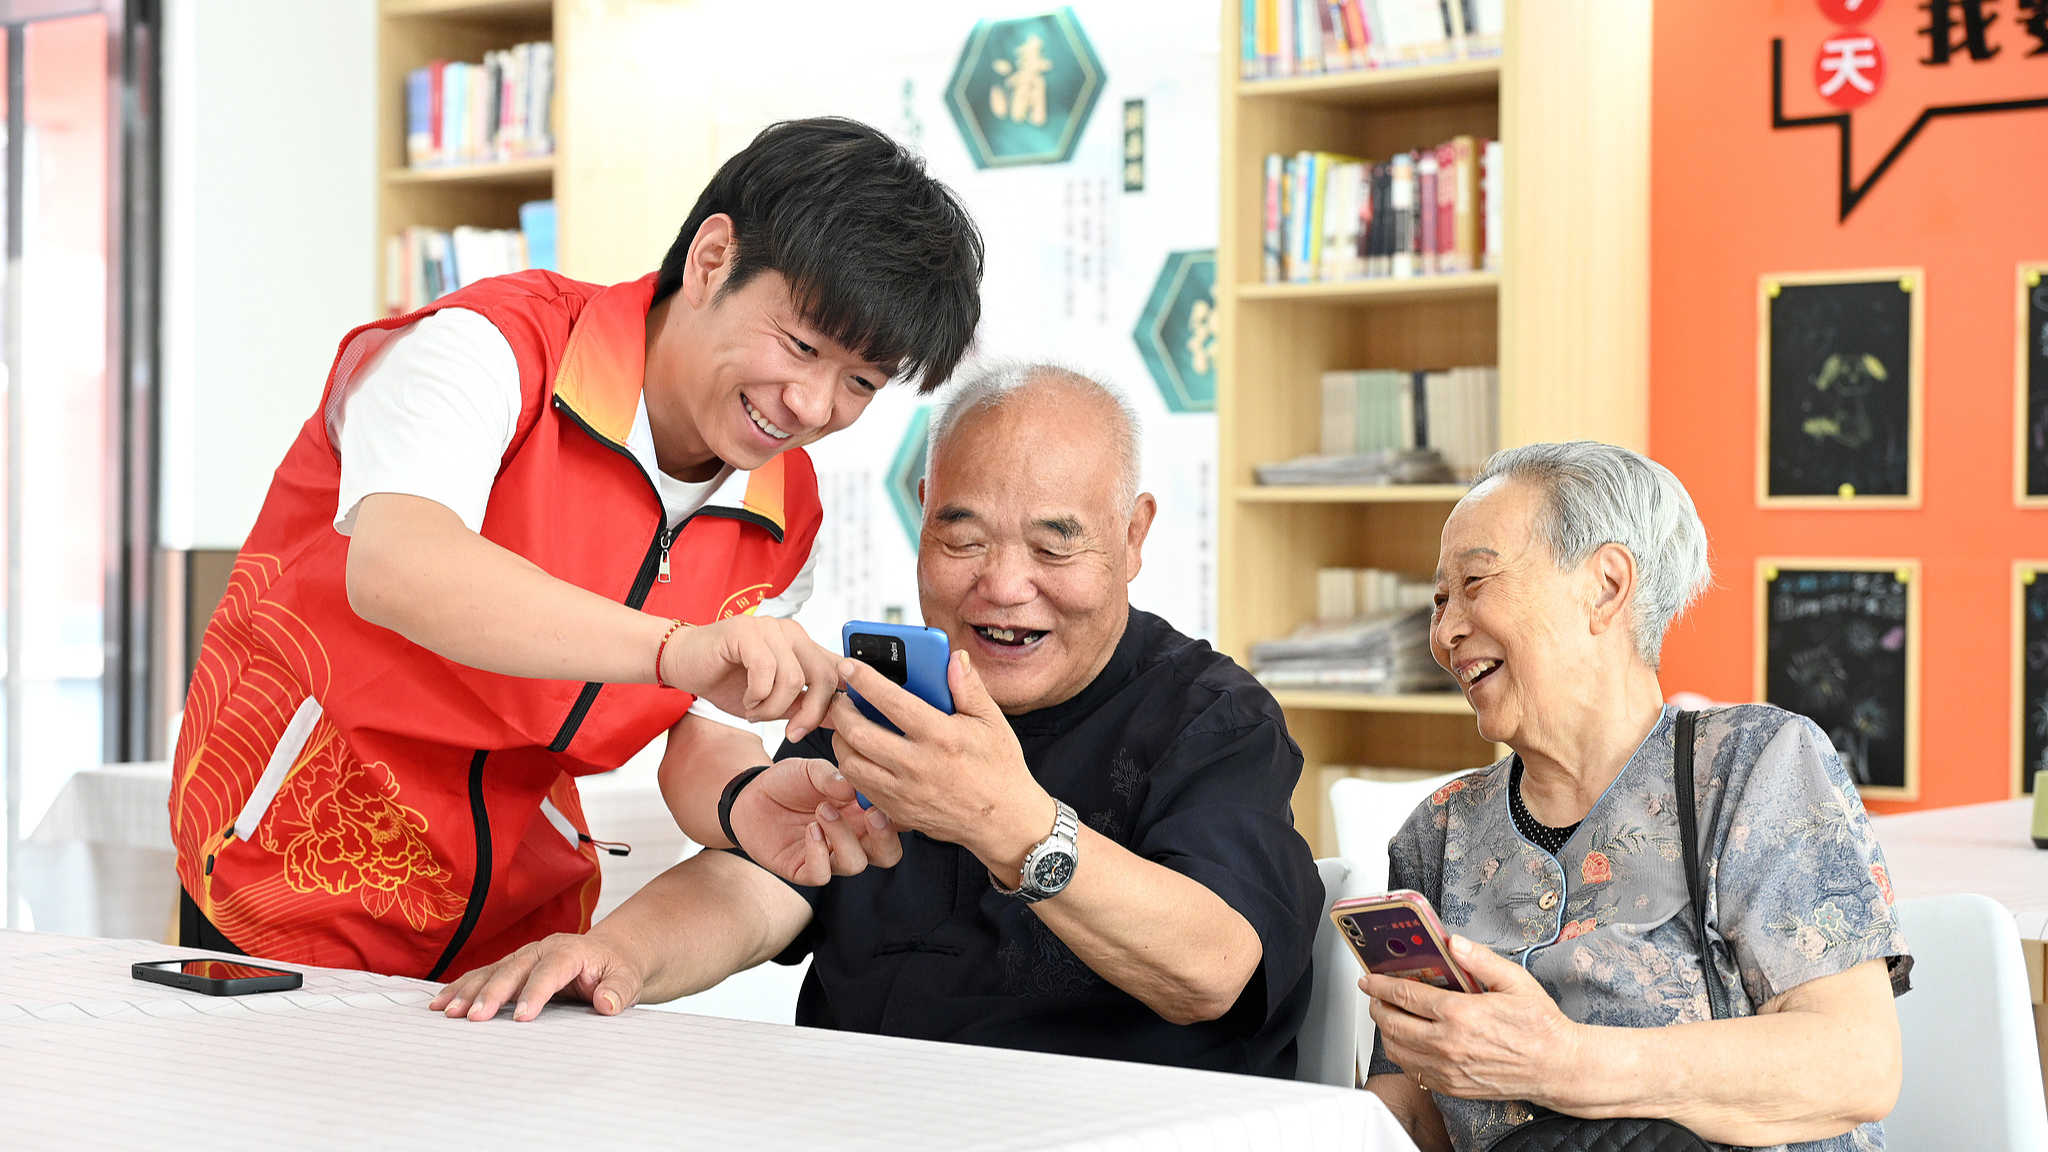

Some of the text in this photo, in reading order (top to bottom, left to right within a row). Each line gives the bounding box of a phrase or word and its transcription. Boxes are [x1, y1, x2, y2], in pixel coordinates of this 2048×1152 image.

[1819, 0, 1877, 97] 天
[1917, 0, 2048, 66] 我
[989, 34, 1052, 127] 清
[890, 641, 898, 662] Redmi
